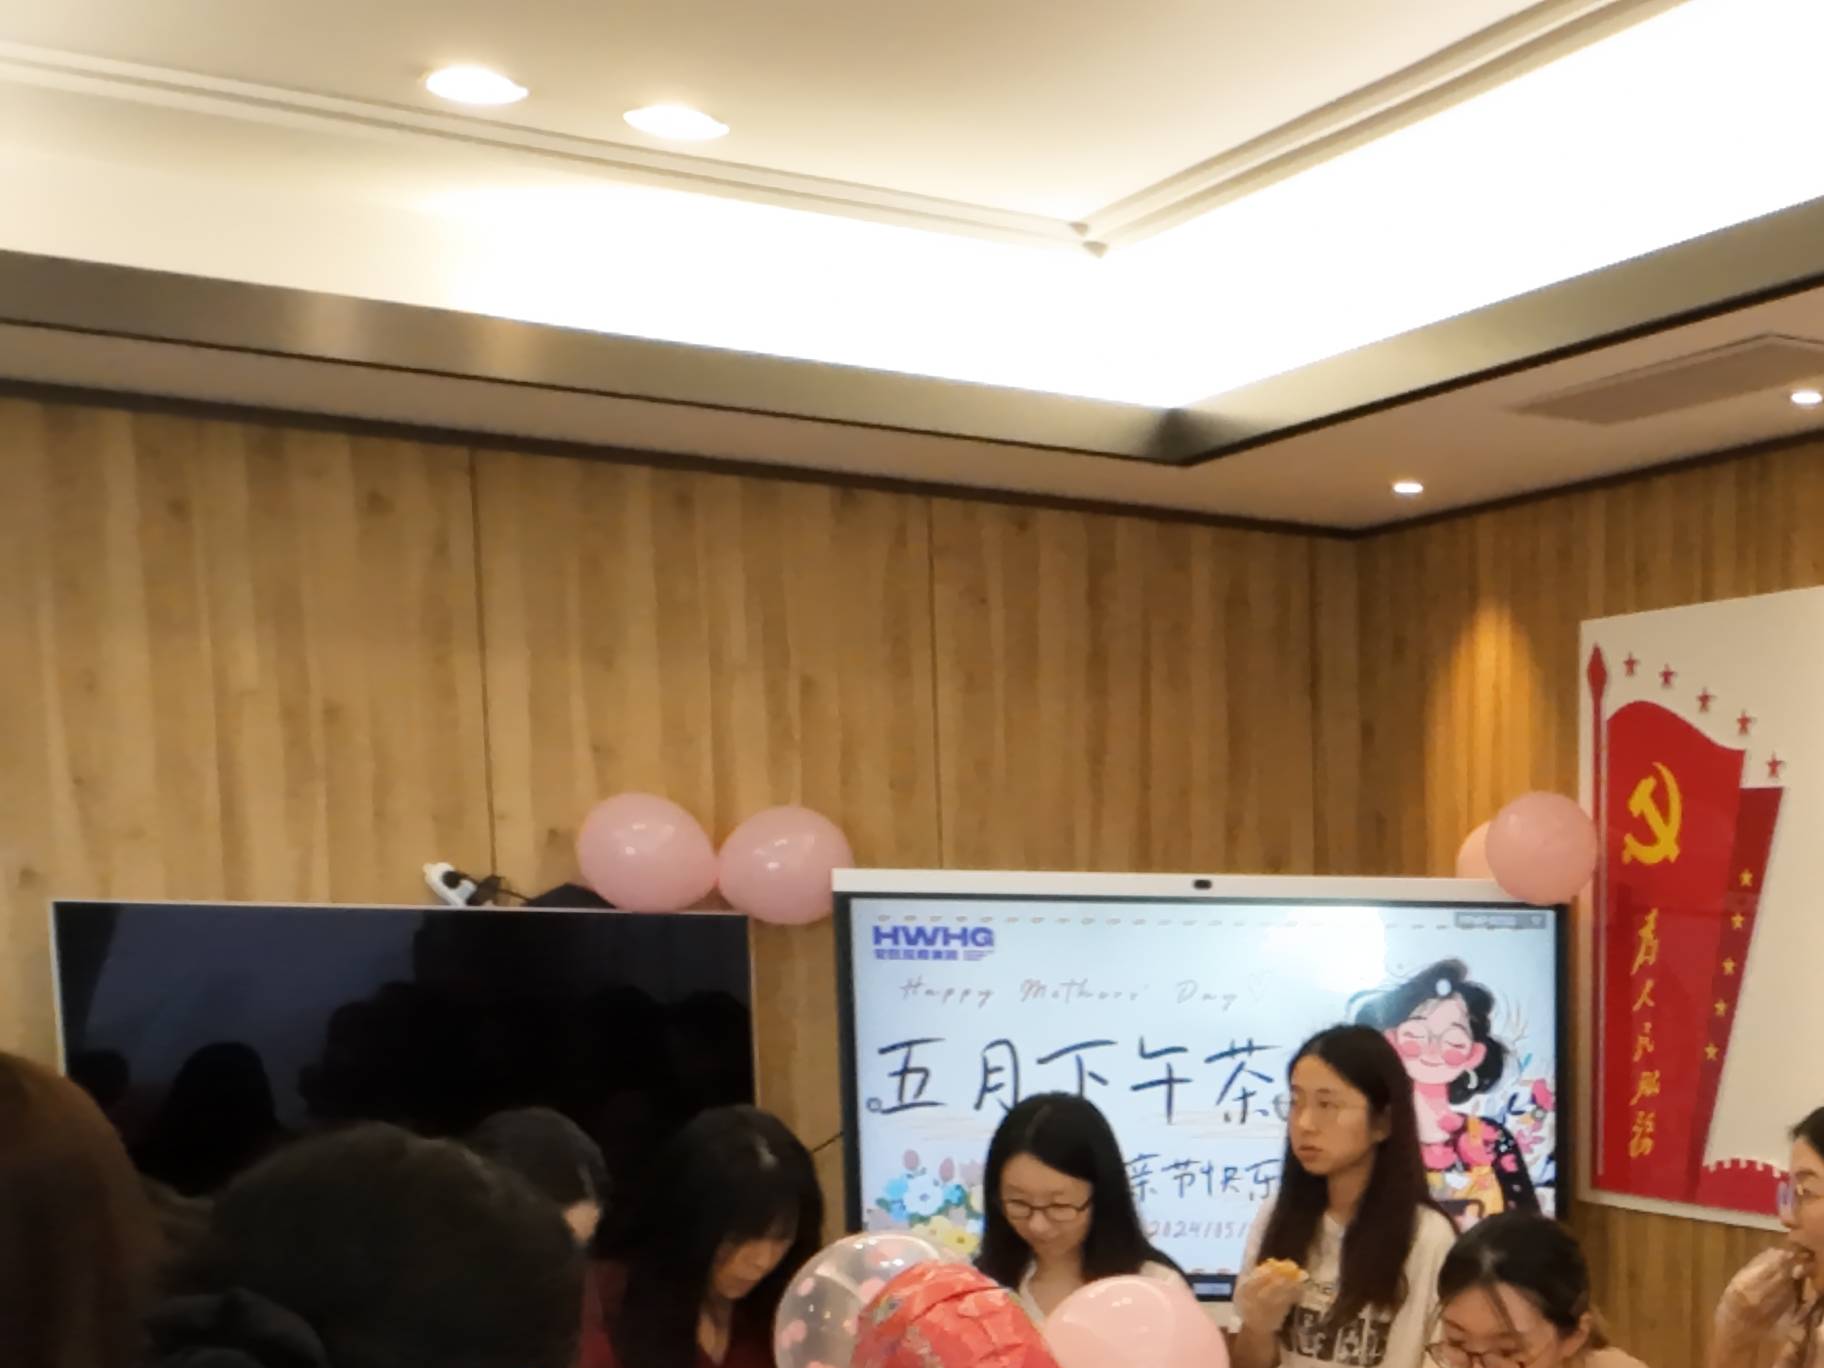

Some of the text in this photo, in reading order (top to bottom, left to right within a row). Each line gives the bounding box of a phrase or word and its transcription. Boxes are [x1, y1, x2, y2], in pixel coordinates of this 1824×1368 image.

[873, 925, 995, 947] HWHG
[900, 974, 993, 1009] Happy
[1176, 978, 1238, 1013] Day
[876, 1036, 1282, 1126] 五月下午茶
